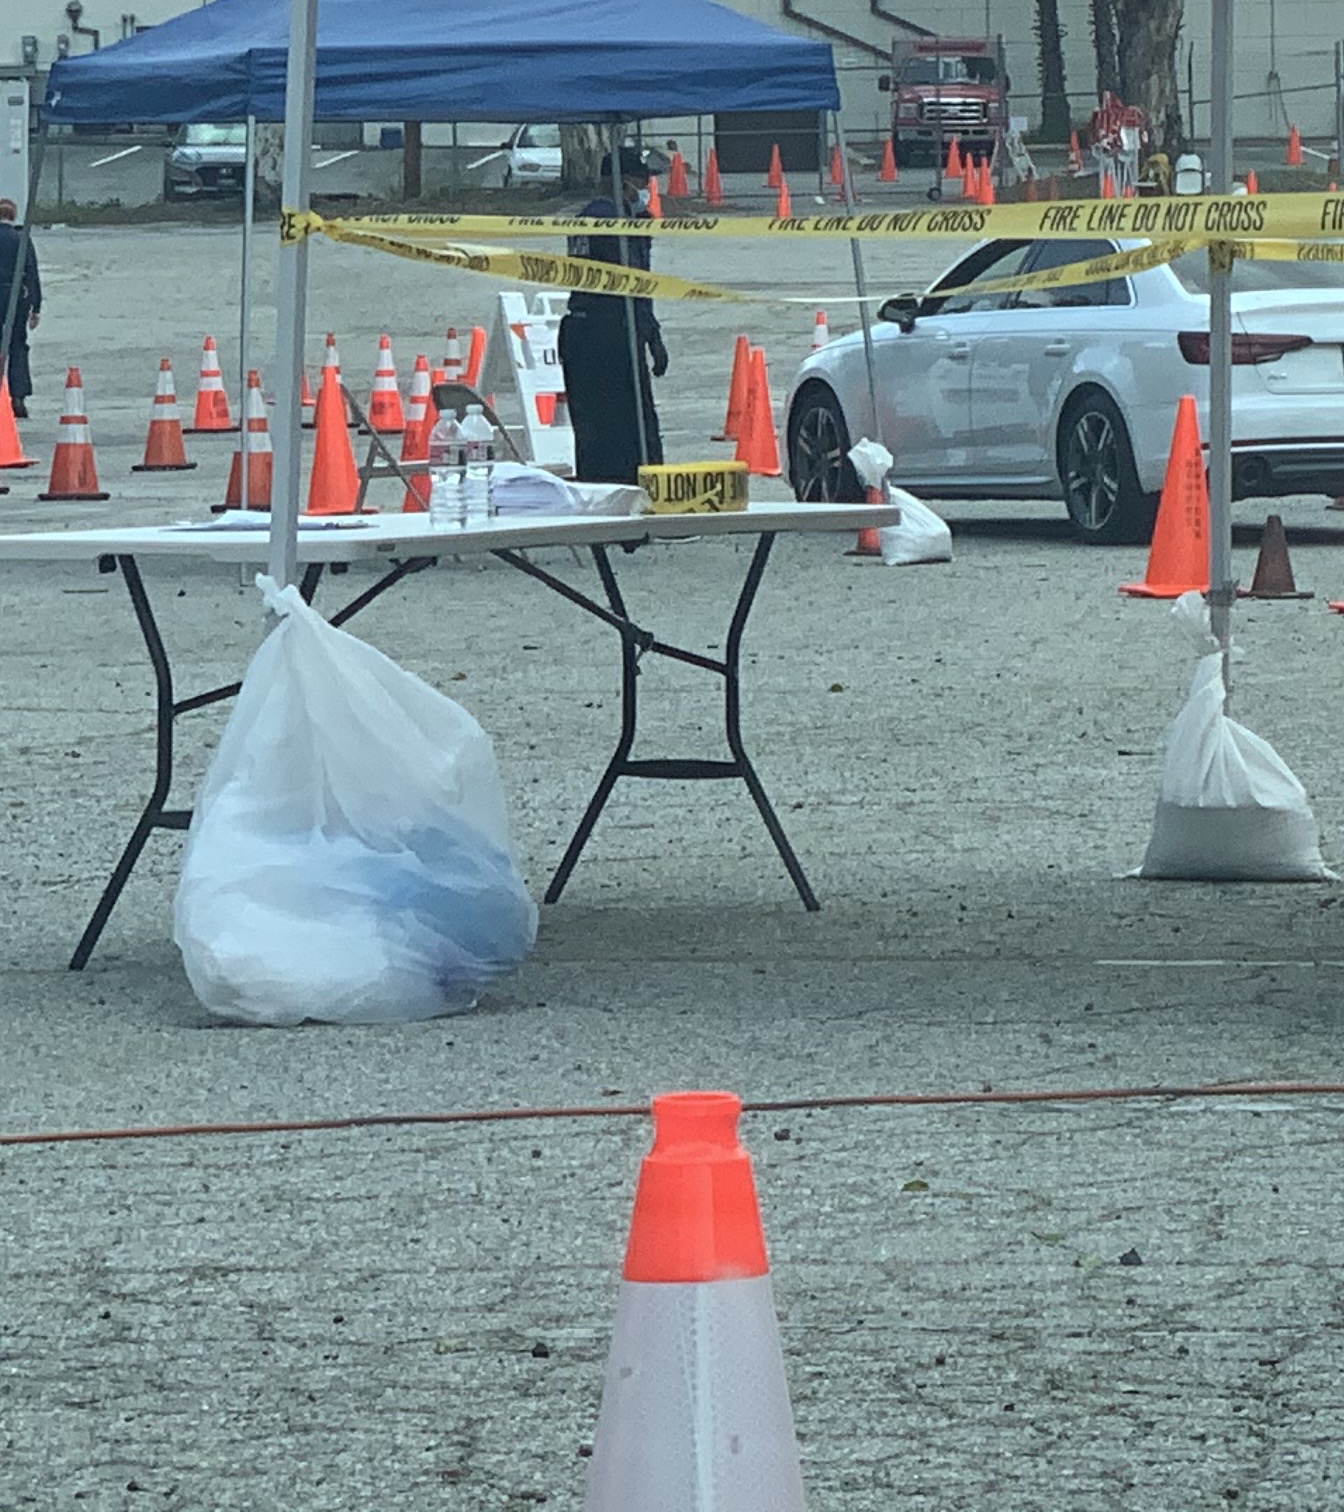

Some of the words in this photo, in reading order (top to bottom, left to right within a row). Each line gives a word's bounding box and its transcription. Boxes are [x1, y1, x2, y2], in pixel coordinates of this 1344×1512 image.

[886, 211, 923, 231] NOT
[927, 208, 992, 231] CROSS
[1039, 205, 1082, 232] FIRE
[1086, 204, 1130, 232] LINE
[1133, 203, 1159, 232] DO
[1163, 202, 1202, 232] NOT
[1205, 201, 1267, 231] CROSS
[519, 254, 559, 283] CROSS
[664, 472, 697, 502] NOT
